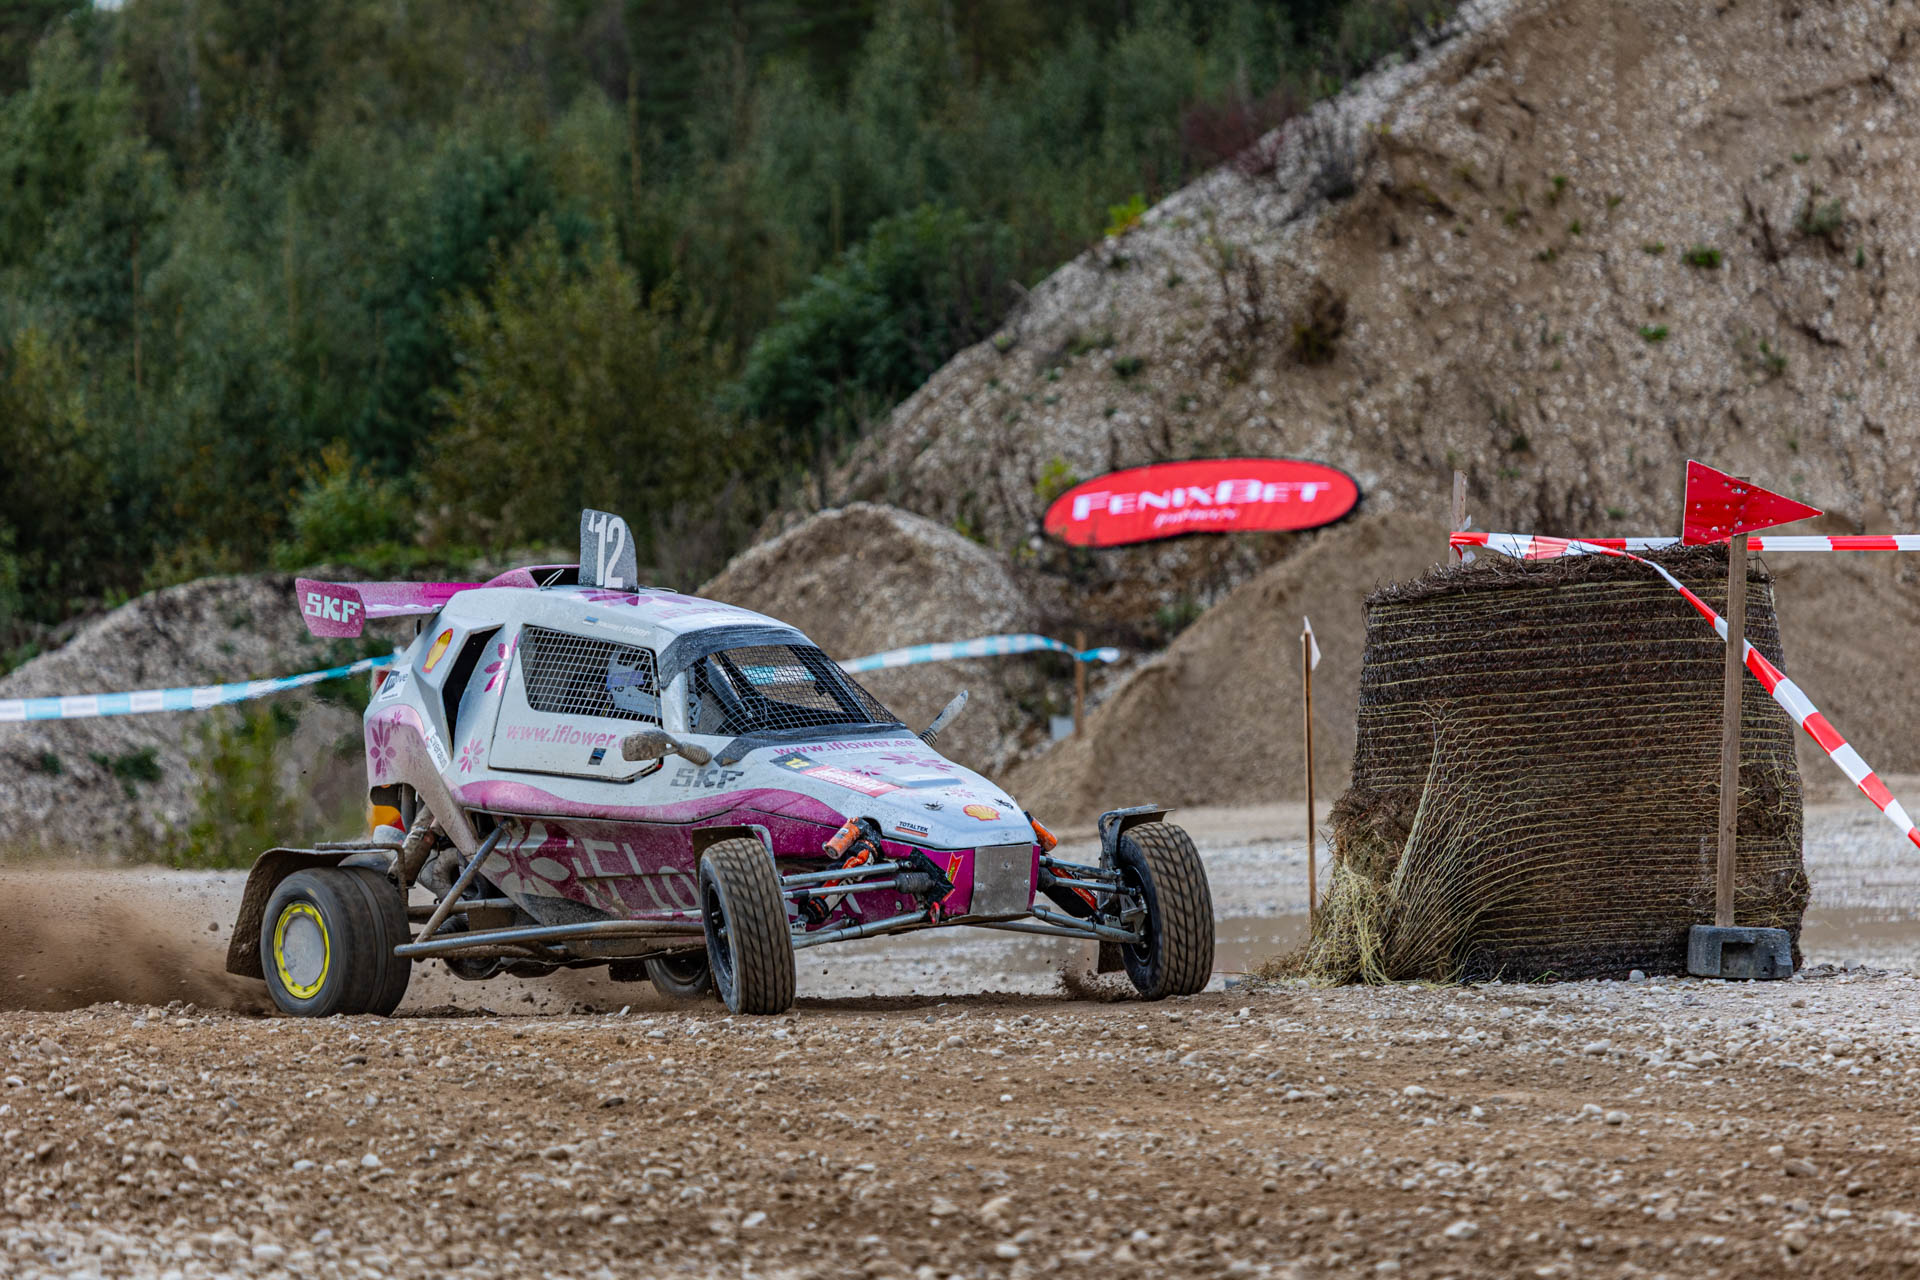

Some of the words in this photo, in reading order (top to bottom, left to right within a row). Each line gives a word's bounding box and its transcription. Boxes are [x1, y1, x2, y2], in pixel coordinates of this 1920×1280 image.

[304, 592, 360, 623] SKF
[773, 739, 917, 755] www.iflower.ee
[670, 767, 744, 789] SKF
[899, 821, 929, 833] TOTALTEK
